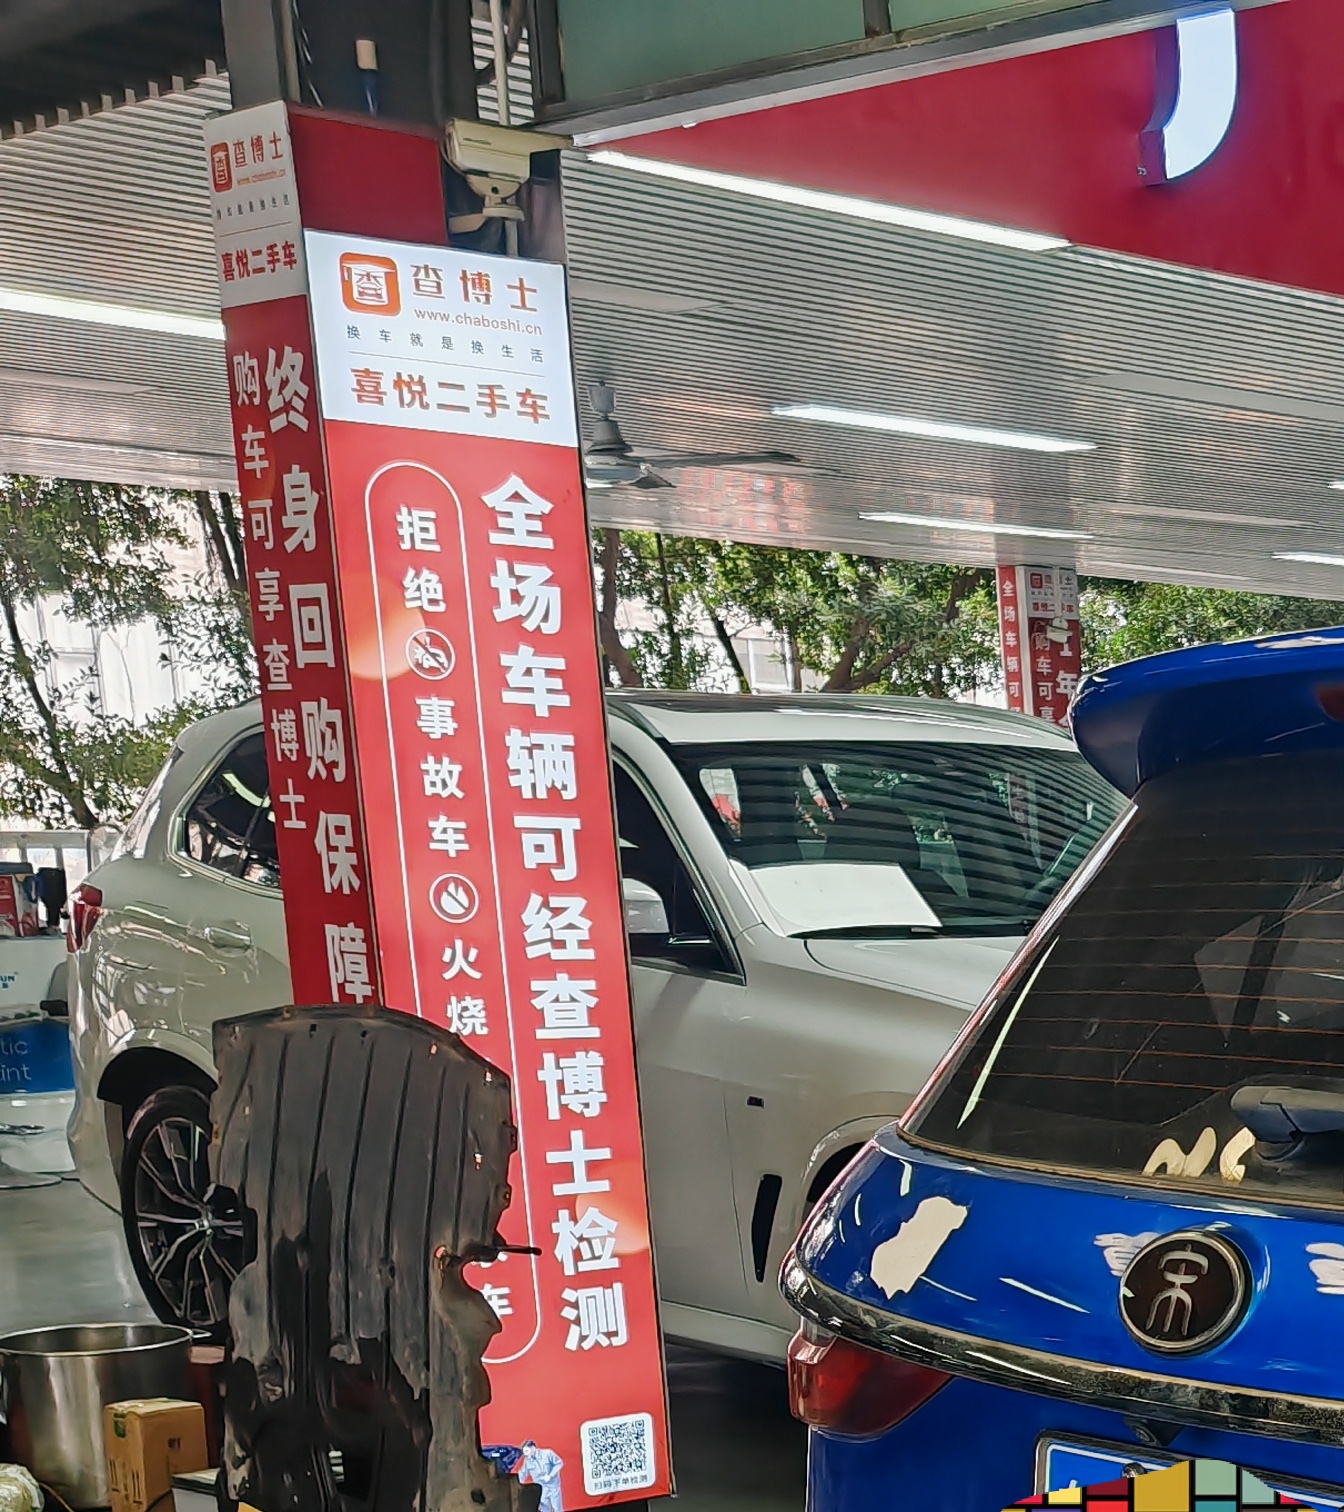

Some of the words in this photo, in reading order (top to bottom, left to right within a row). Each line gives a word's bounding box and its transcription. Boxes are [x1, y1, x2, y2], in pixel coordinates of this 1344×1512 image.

[221, 240, 297, 283] 喜悦二手车
[410, 264, 538, 313] 查博士
[346, 324, 544, 364] 换车就是换生活
[414, 308, 543, 336] www.chaboshi.cn
[350, 367, 551, 425] 喜悦二手车
[232, 350, 307, 830] 购车可享查博士
[395, 506, 448, 614] 拒绝
[264, 345, 372, 1005] 终身回购保障
[414, 696, 471, 859] 事故车
[481, 473, 628, 1353] 全场车辆可经查博士检测
